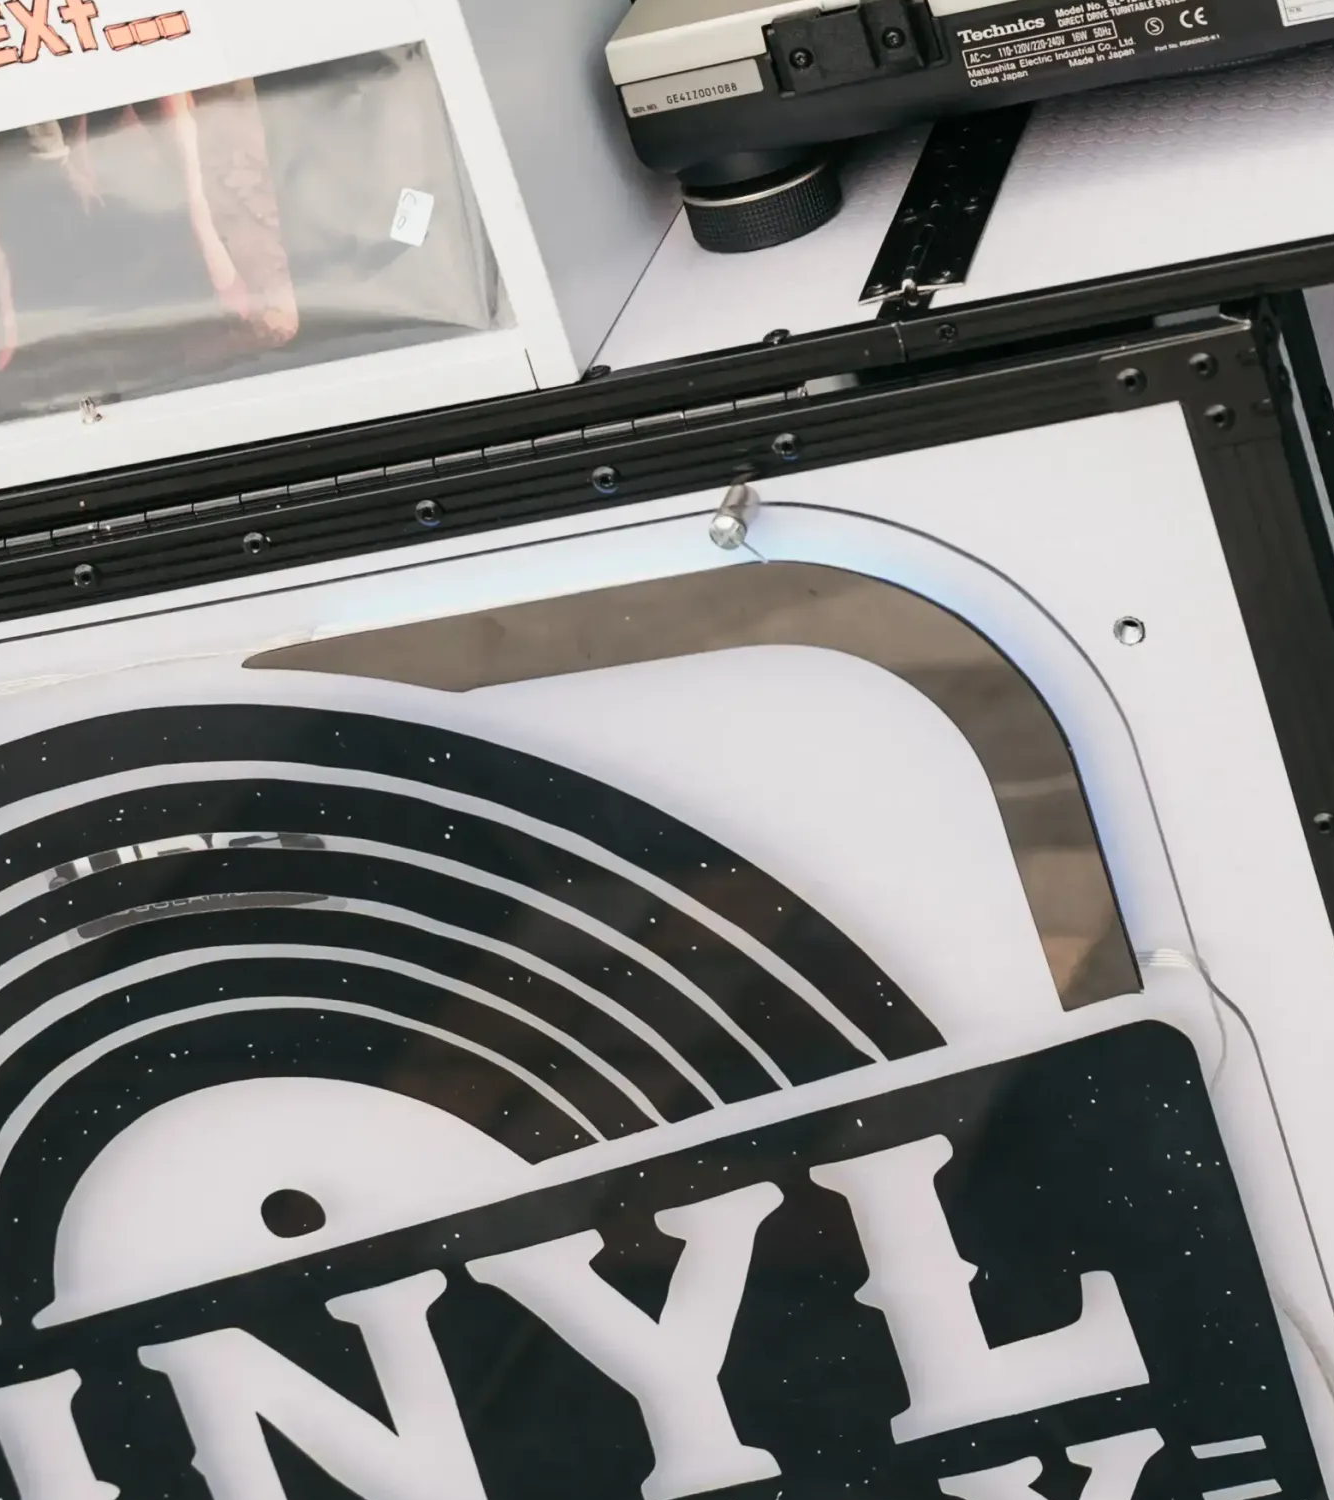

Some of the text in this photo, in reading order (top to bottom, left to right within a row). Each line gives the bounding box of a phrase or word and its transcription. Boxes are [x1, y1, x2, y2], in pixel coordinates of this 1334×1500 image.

[1055, 2, 1085, 19] Model
[1086, 0, 1104, 13] No.
[1057, 12, 1085, 28] DIRECT
[1086, 7, 1110, 22] DRIVE
[957, 16, 1046, 44] Technics
[1092, 25, 1113, 39] 50Hz
[967, 61, 1016, 79] Matsushita
[1019, 52, 1053, 69] Electric
[1055, 43, 1096, 61] Industrial
[1068, 46, 1136, 69] Made in Japan
[970, 69, 1029, 89] Osaka Japan
